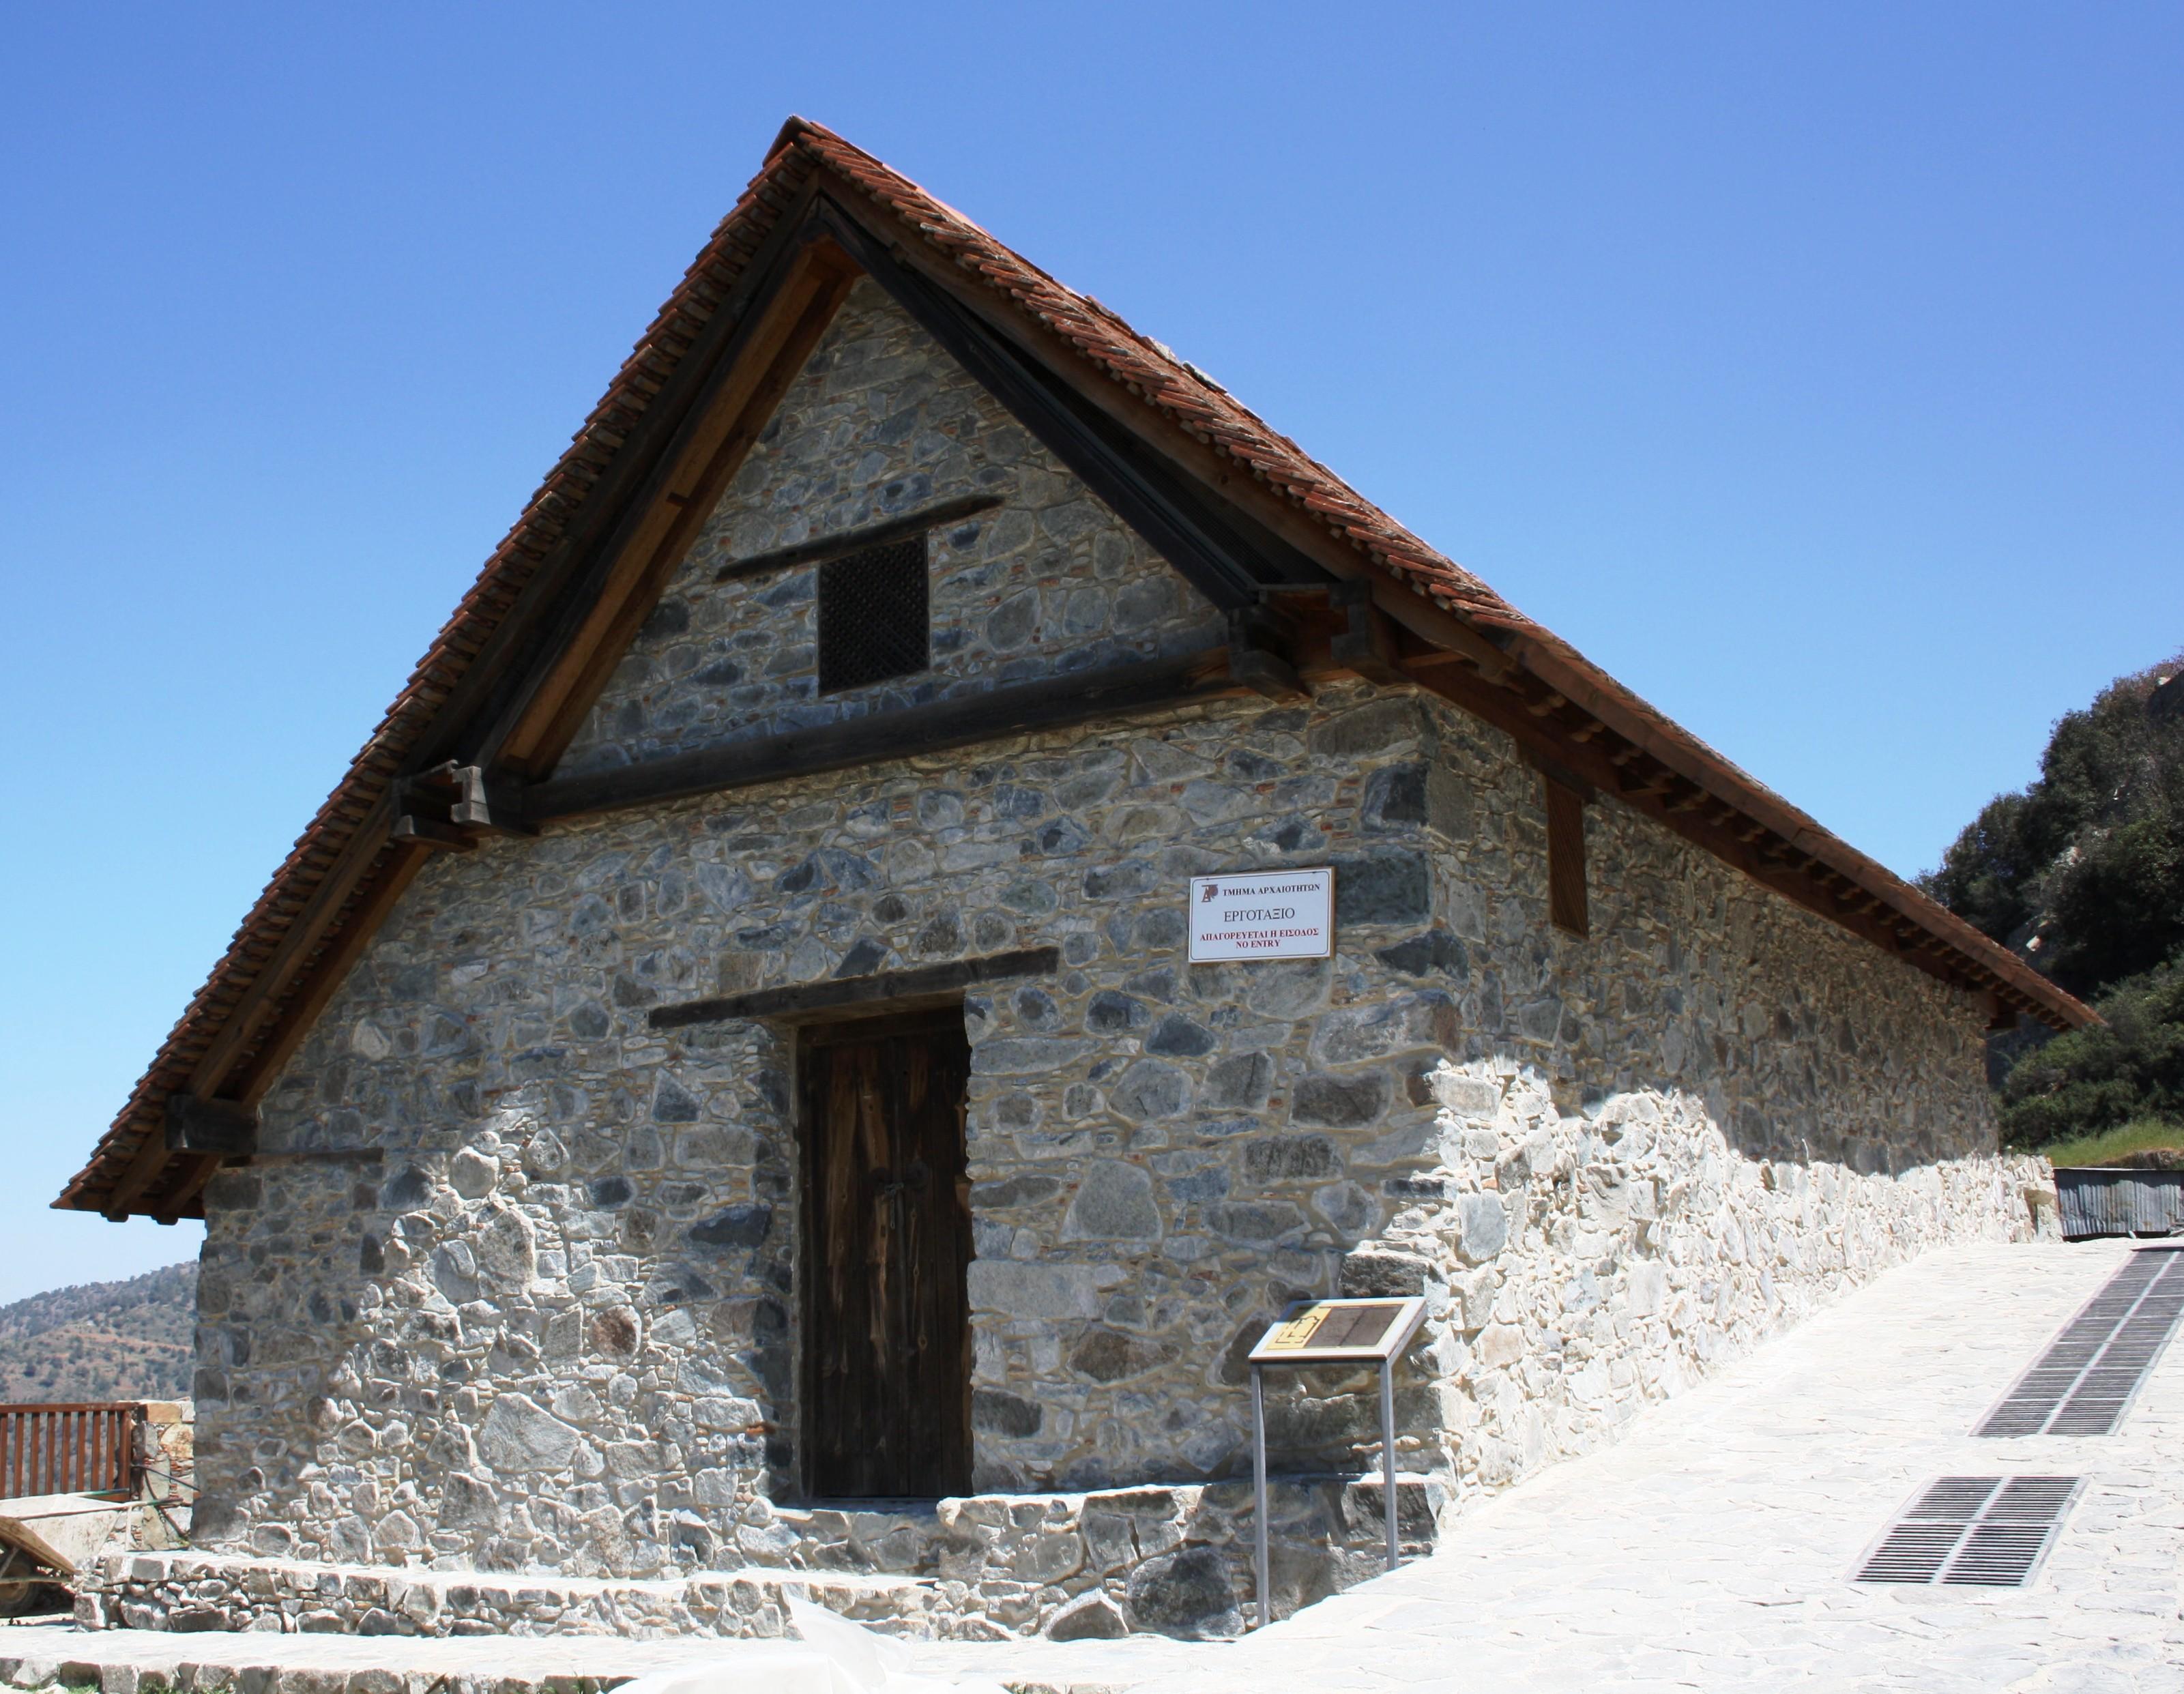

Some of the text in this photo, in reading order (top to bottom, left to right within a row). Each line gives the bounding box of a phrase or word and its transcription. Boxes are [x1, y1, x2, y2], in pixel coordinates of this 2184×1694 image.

[1223, 883, 1320, 896] ΤΜΗΜΑ ΑΡΧΑΙΟΤΗΤΩΝ
[1224, 907, 1295, 922] ΕΡΓΟΤΑΞΙΟ
[1199, 930, 1268, 941] ΑΠΑΓΟΡΕΥΕΤΑΙ
[1279, 928, 1319, 937] ΕΙΣΟΔΟΣ
[1251, 939, 1281, 948] ENTRY
